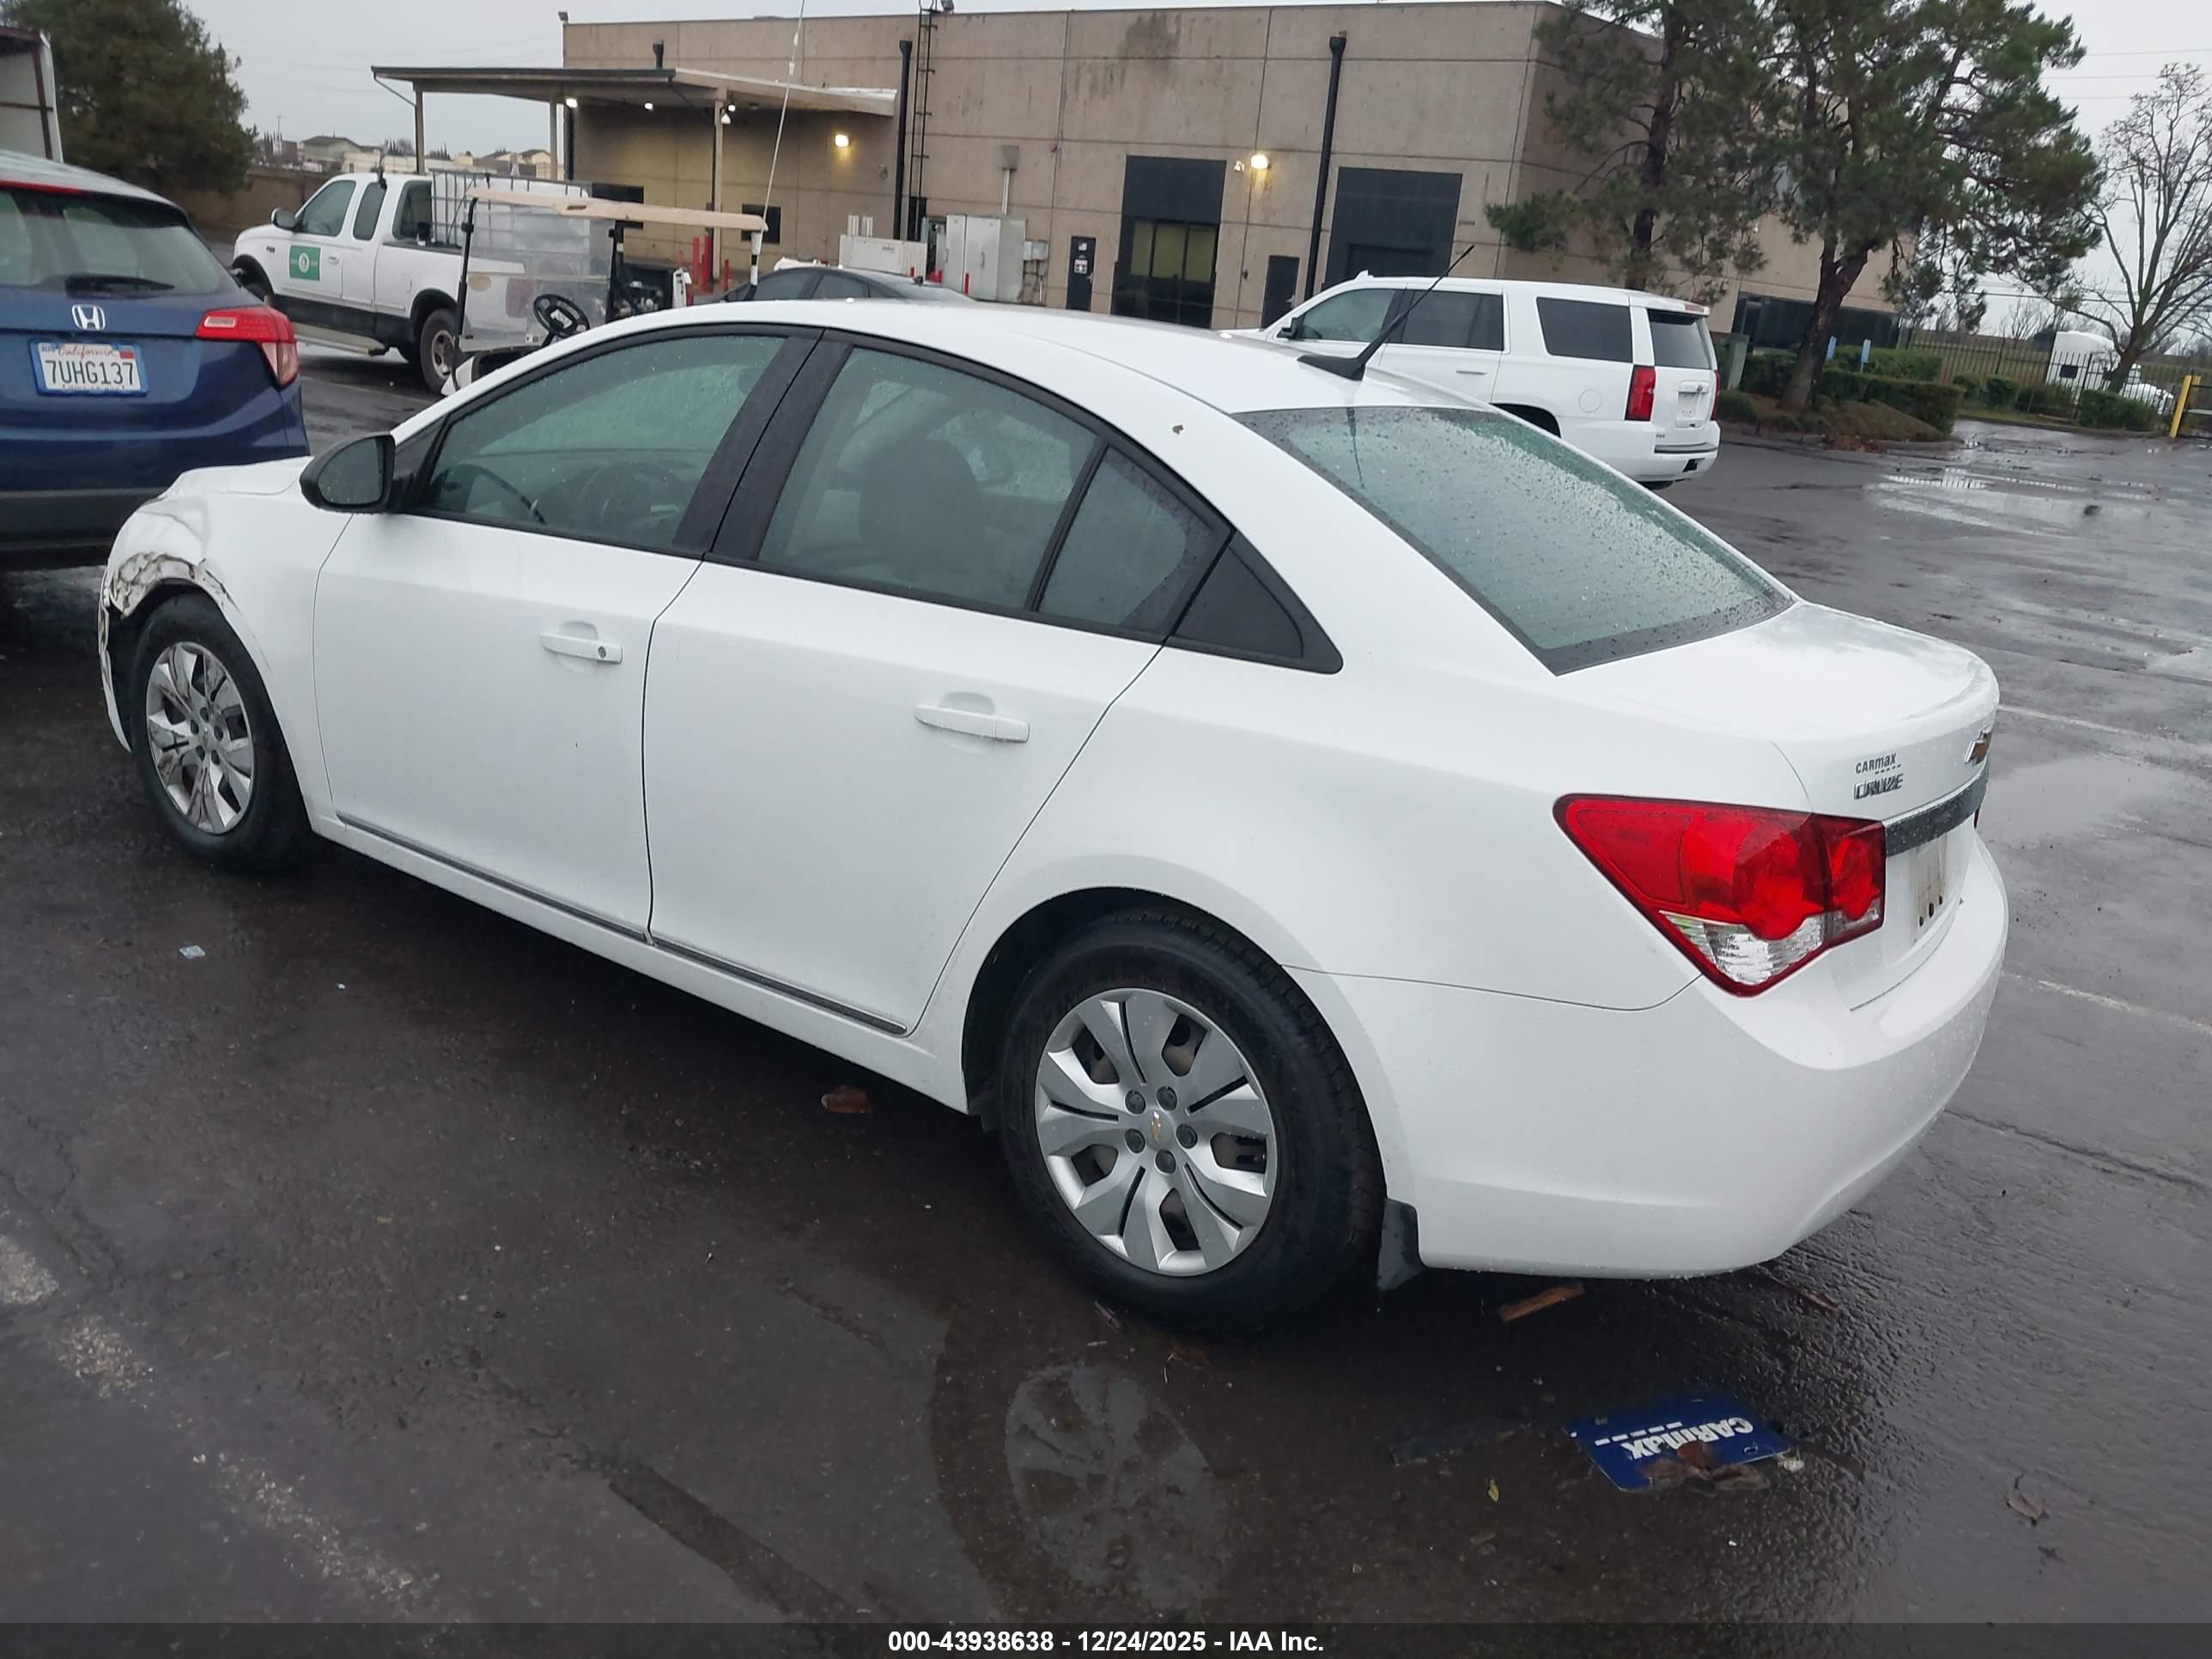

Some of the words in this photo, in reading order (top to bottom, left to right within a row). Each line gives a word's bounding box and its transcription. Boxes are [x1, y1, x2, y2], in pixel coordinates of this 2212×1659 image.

[58, 344, 115, 361] California
[45, 360, 134, 386] 7UHG137
[1854, 773, 1904, 800] CRUZE
